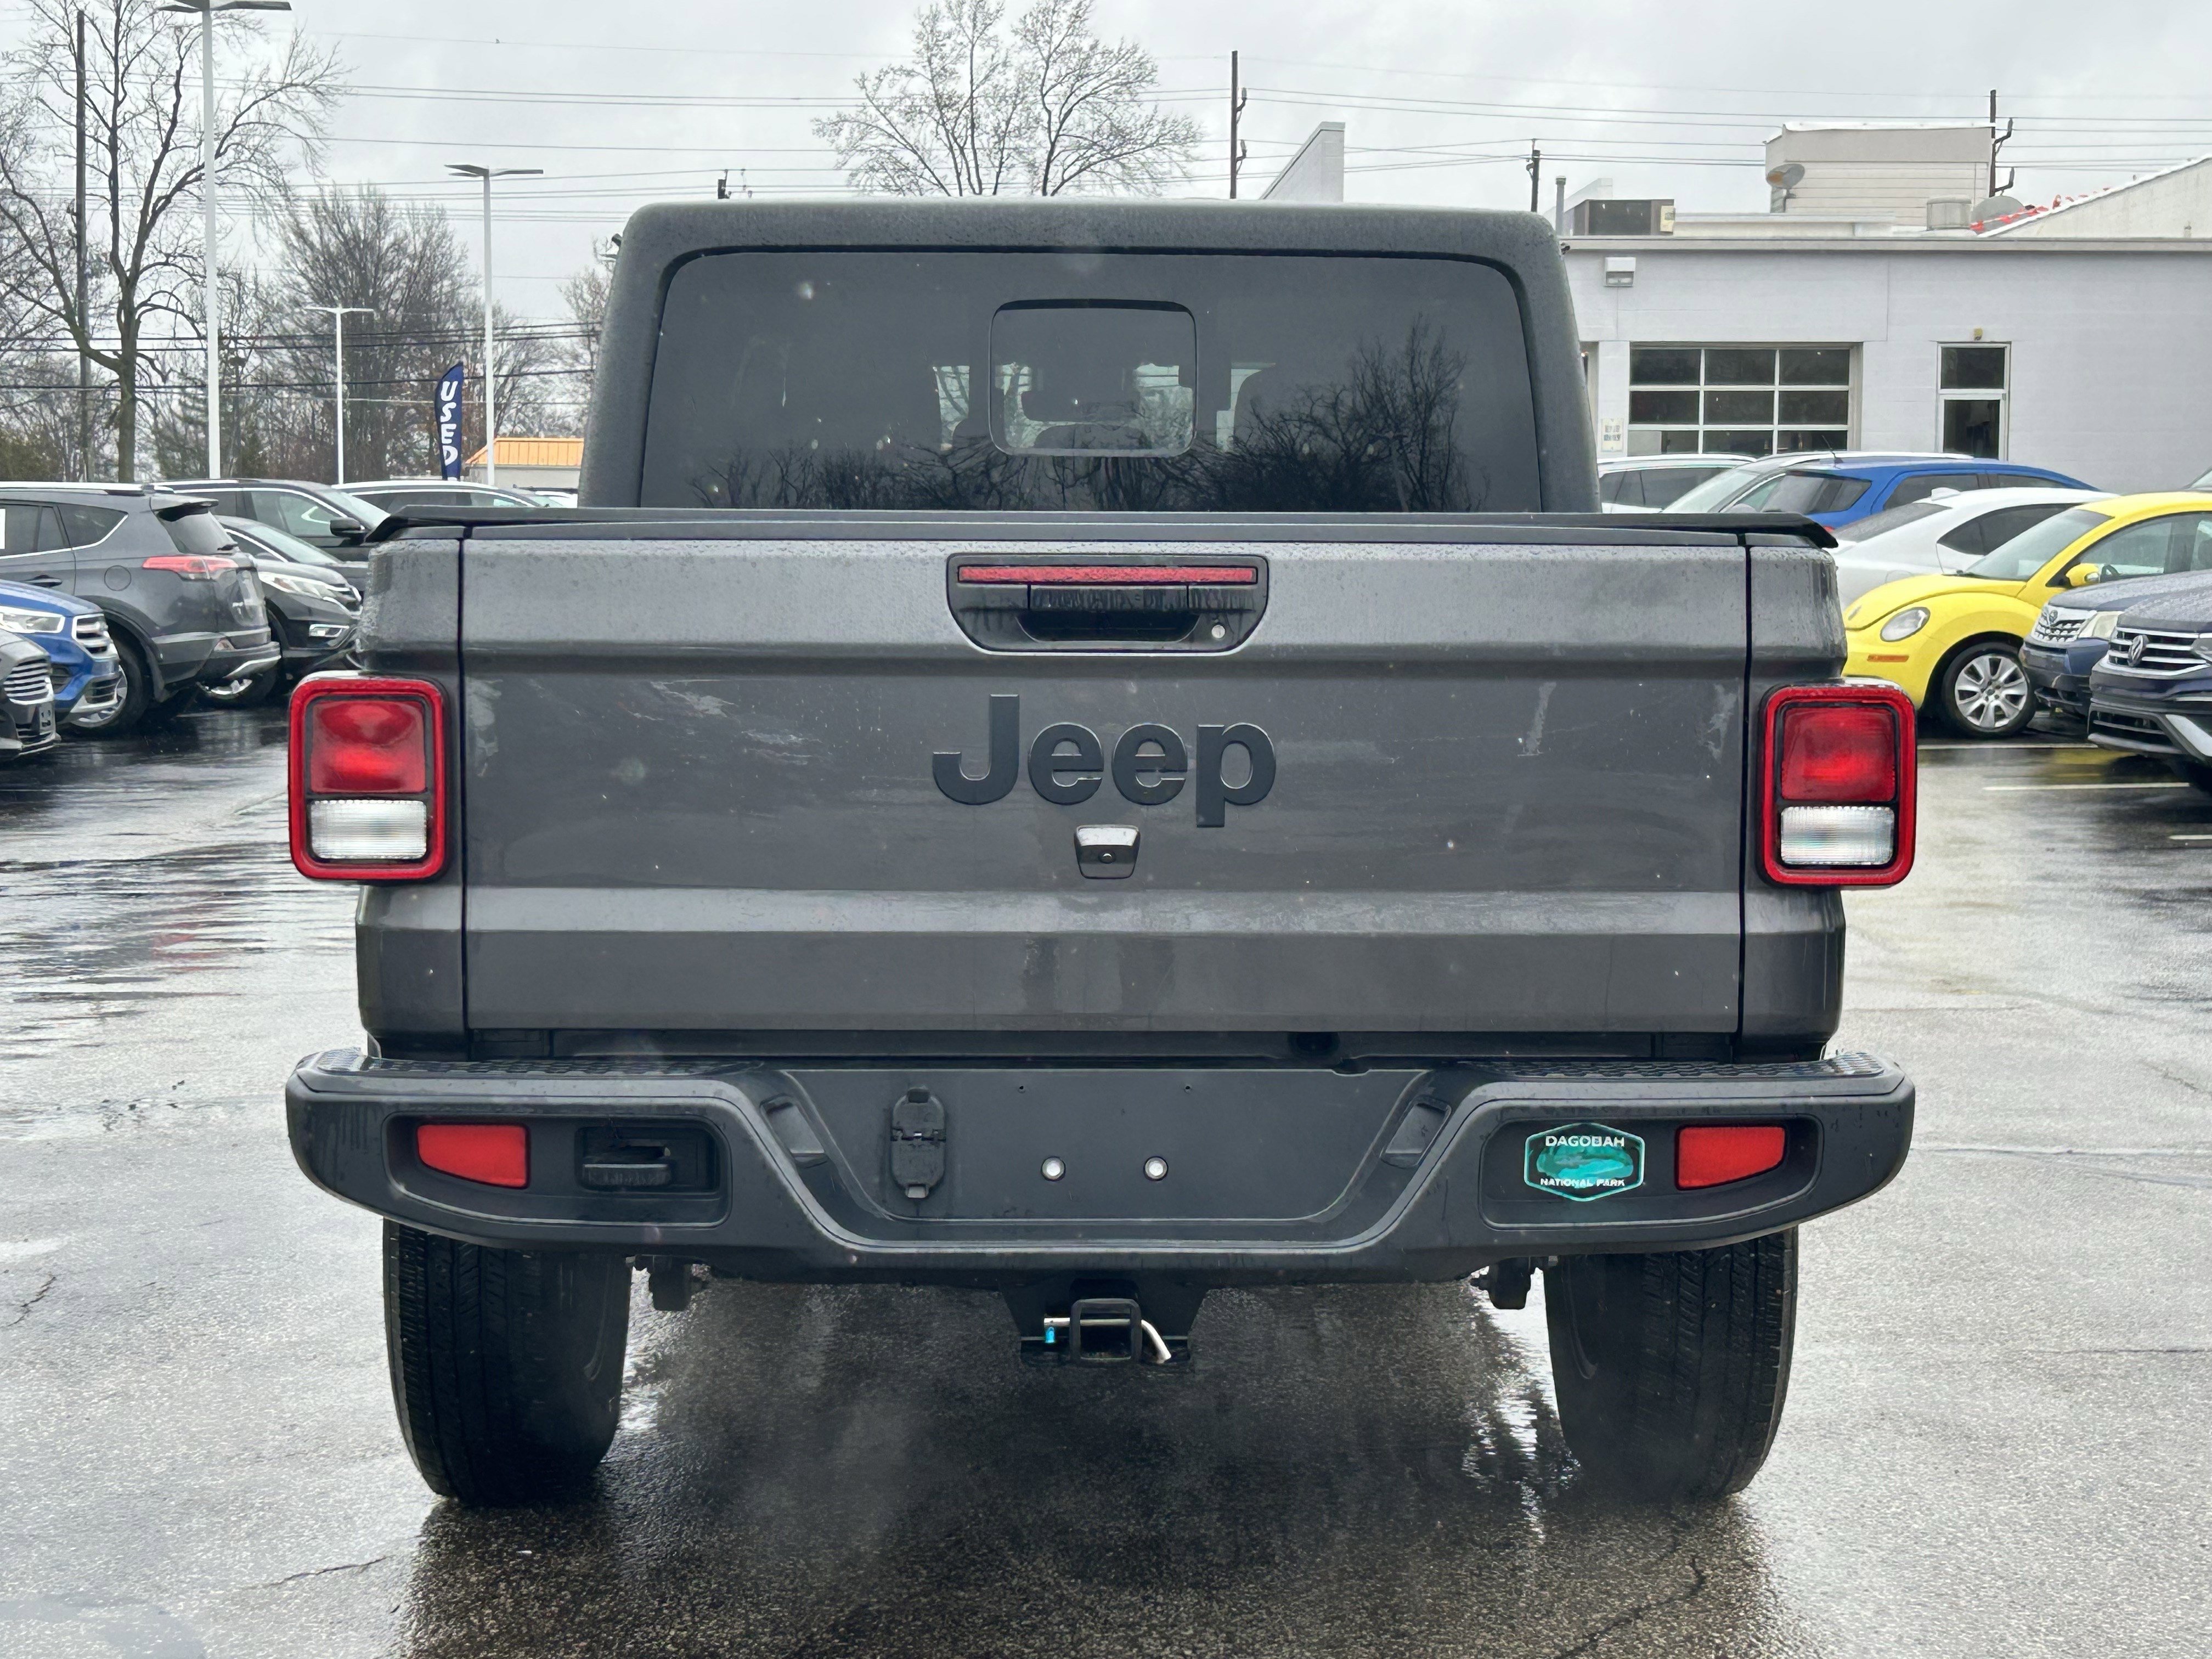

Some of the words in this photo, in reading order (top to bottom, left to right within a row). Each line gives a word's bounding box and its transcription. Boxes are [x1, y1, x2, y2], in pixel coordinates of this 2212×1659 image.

[440, 381, 459, 466] USED
[933, 693, 1277, 828] Jeep
[1545, 1136, 1625, 1147] DAGOBAH
[1540, 1178, 1594, 1188] NATIONAL
[1596, 1178, 1625, 1187] PARK
